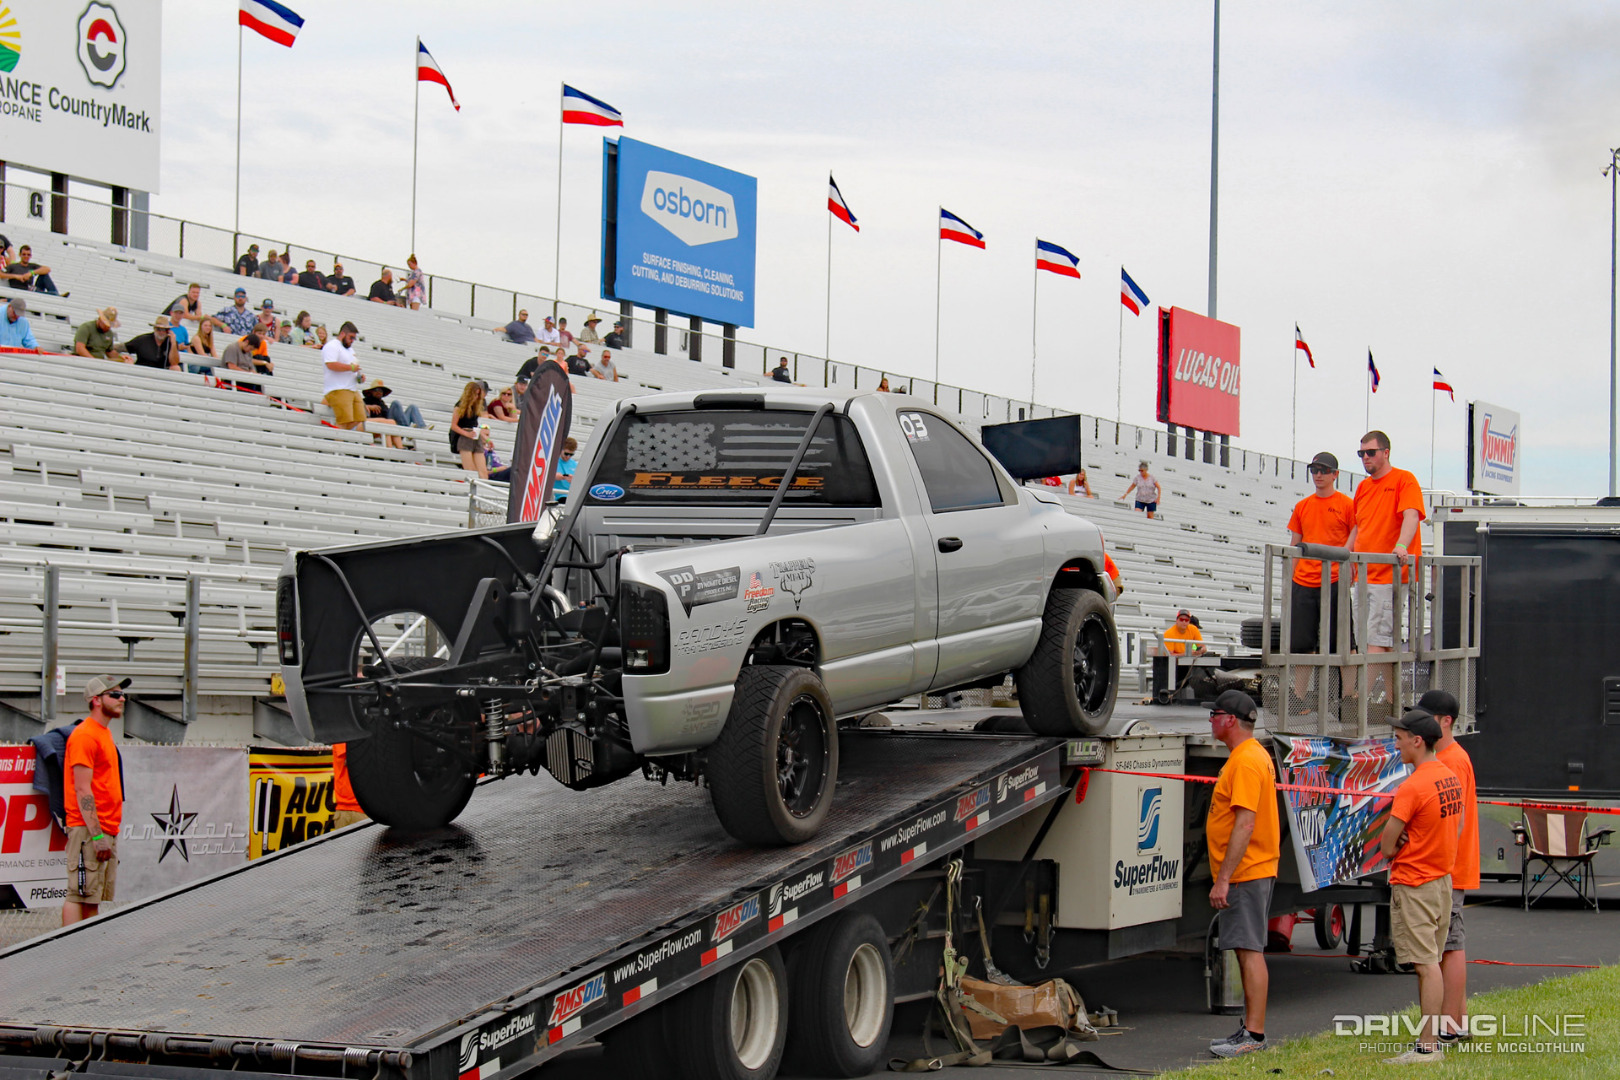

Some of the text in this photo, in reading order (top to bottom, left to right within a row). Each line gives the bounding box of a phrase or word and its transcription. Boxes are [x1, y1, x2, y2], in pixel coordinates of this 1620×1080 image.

[49, 87, 150, 133] CountryMark
[30, 192, 43, 218] G
[654, 186, 727, 229] osborn
[631, 264, 744, 302] CUTTING, AND DEBURRING SOLUTIONS
[642, 252, 735, 288] SURFACE FINISHING, CLEANING,
[1174, 348, 1240, 396] LUCAS OIL
[900, 413, 928, 438] 03
[1481, 418, 1515, 466] SUMMIT
[521, 385, 563, 523] AMSOIL
[631, 472, 825, 486] FLEECE
[669, 572, 694, 585] DD
[681, 585, 692, 597] P
[744, 587, 775, 600] Freedom
[1126, 632, 1135, 665] F
[15, 754, 24, 771] in
[1008, 766, 1039, 790] SuperFlow
[1133, 760, 1151, 769] Chassis
[1152, 758, 1183, 770] Dynamometer
[1434, 776, 1461, 791] FLEEC
[1438, 787, 1463, 805] EVEN
[953, 783, 991, 822] AMSOIL
[1440, 800, 1464, 819] STAF
[880, 810, 947, 852] www.SuperFlow.com
[191, 842, 247, 855] cams
[829, 841, 874, 883] AMSOIL
[783, 871, 824, 901] SuperFlow
[1114, 855, 1179, 896] SuperFlow
[712, 894, 760, 942] AMSOIL
[613, 929, 702, 984] www.SuperFlow.com
[549, 973, 606, 1026] AMSOIL
[480, 1012, 535, 1050] SuperFlow
